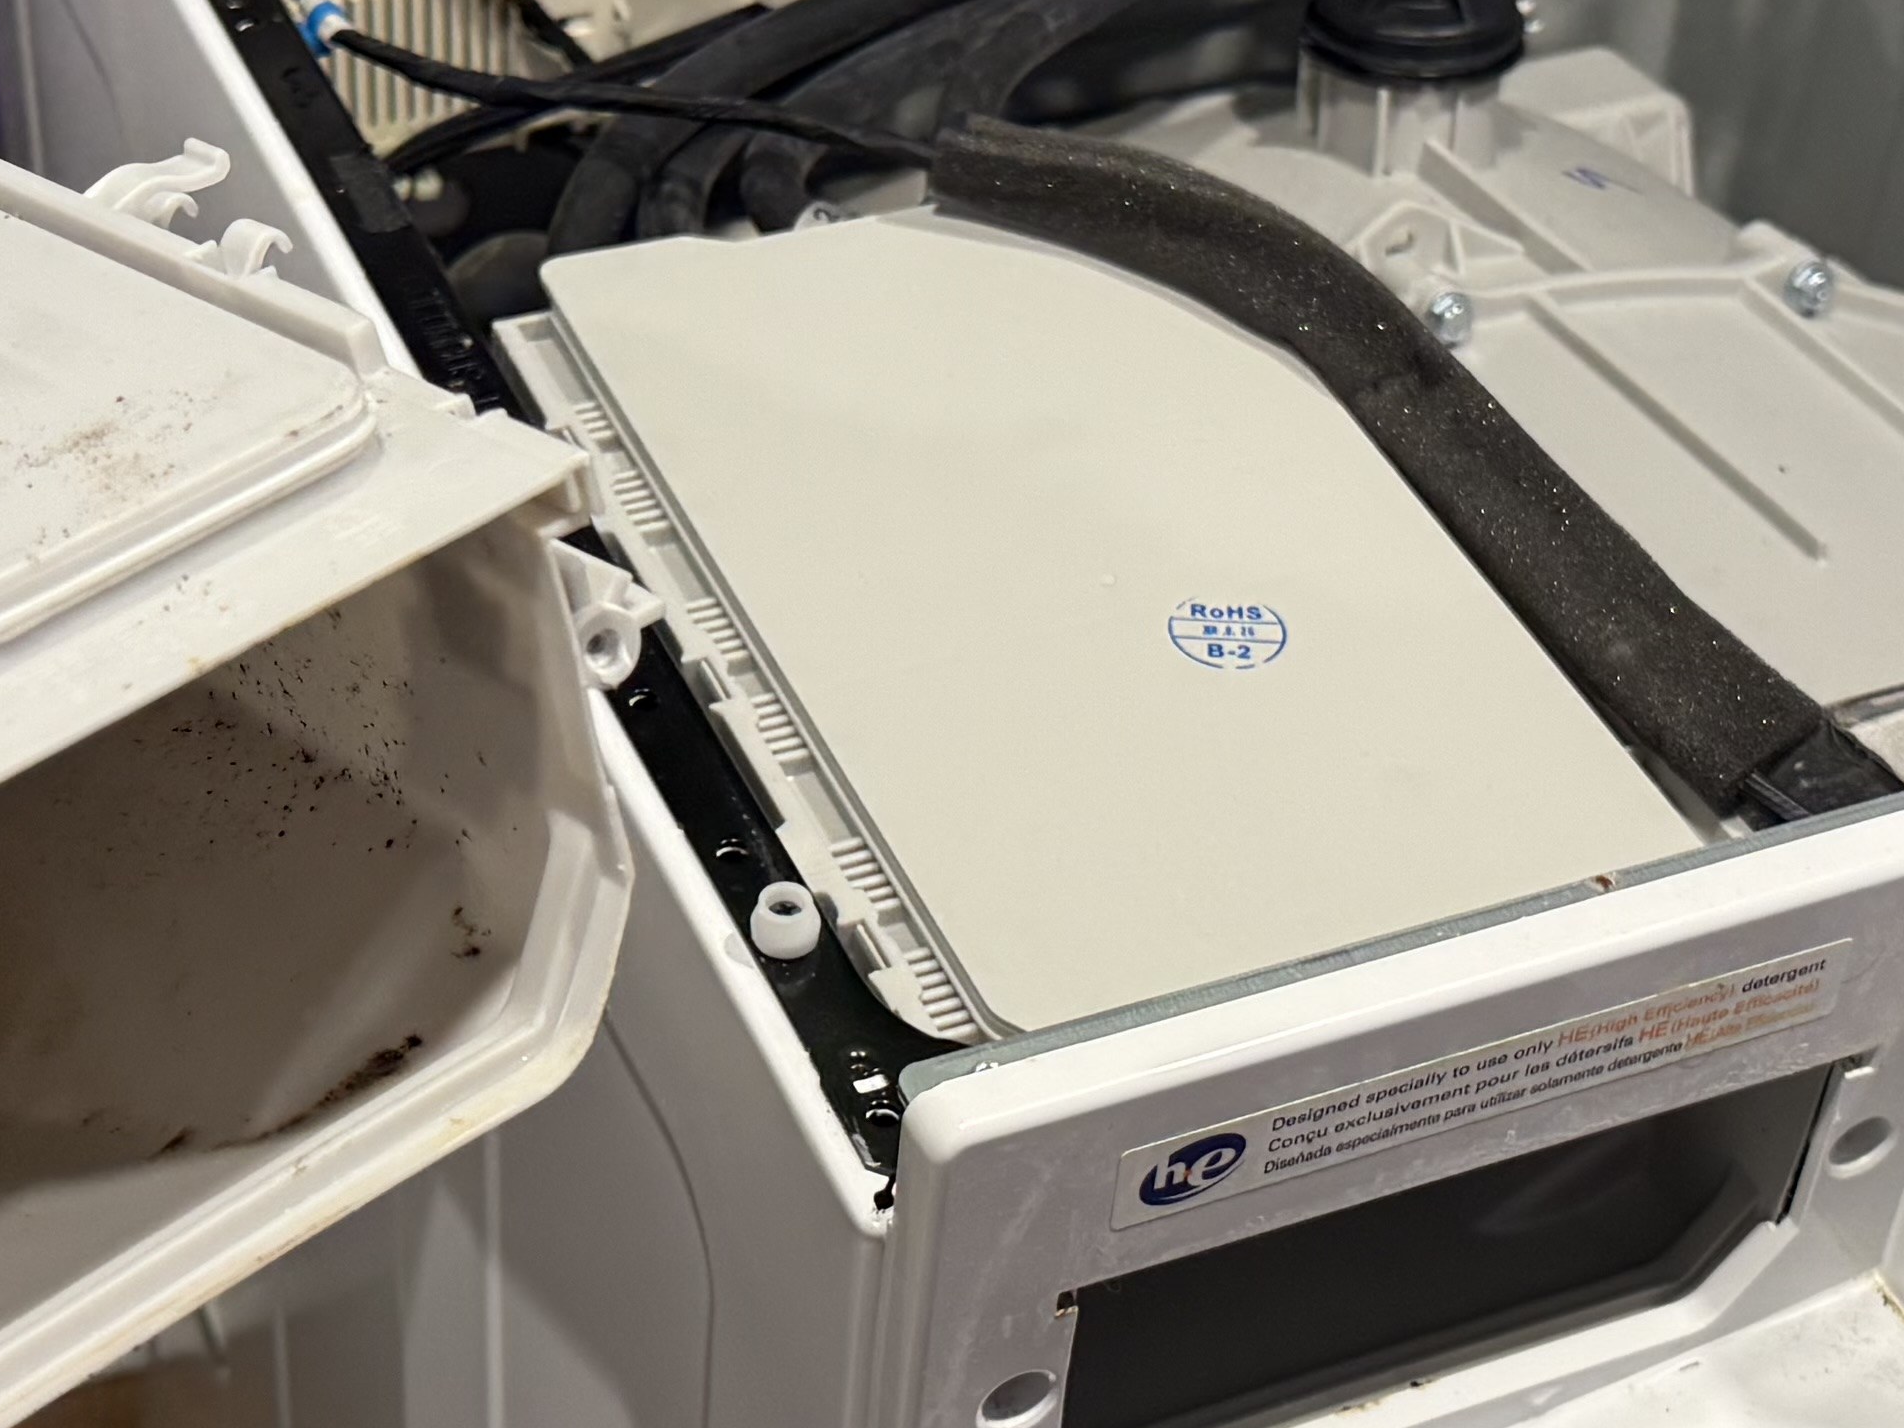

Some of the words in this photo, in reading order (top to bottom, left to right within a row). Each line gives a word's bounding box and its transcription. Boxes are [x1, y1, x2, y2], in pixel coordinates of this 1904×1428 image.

[1190, 603, 1263, 621] RoHS
[1207, 643, 1252, 660] B-2
[1263, 1144, 1332, 1174] Diseñada
[1335, 1112, 1441, 1153] especialmente
[1443, 1101, 1476, 1122] para
[1479, 1084, 1526, 1109] utilizar
[1530, 1062, 1604, 1096] solamente
[1607, 1040, 1684, 1073] detergente
[1267, 1125, 1329, 1153] Conçu
[1334, 1083, 1471, 1135] exclusivement
[1475, 1068, 1520, 1094] pour
[1524, 1059, 1550, 1078] les
[1555, 1034, 1634, 1067] détersifs
[1638, 1020, 1668, 1044] HE
[1271, 1094, 1360, 1132] Designed
[1365, 1072, 1447, 1108] specially
[1452, 1063, 1471, 1078] to
[1476, 1055, 1508, 1072] use
[1514, 1038, 1554, 1061] only
[1741, 958, 1826, 994] detergent
